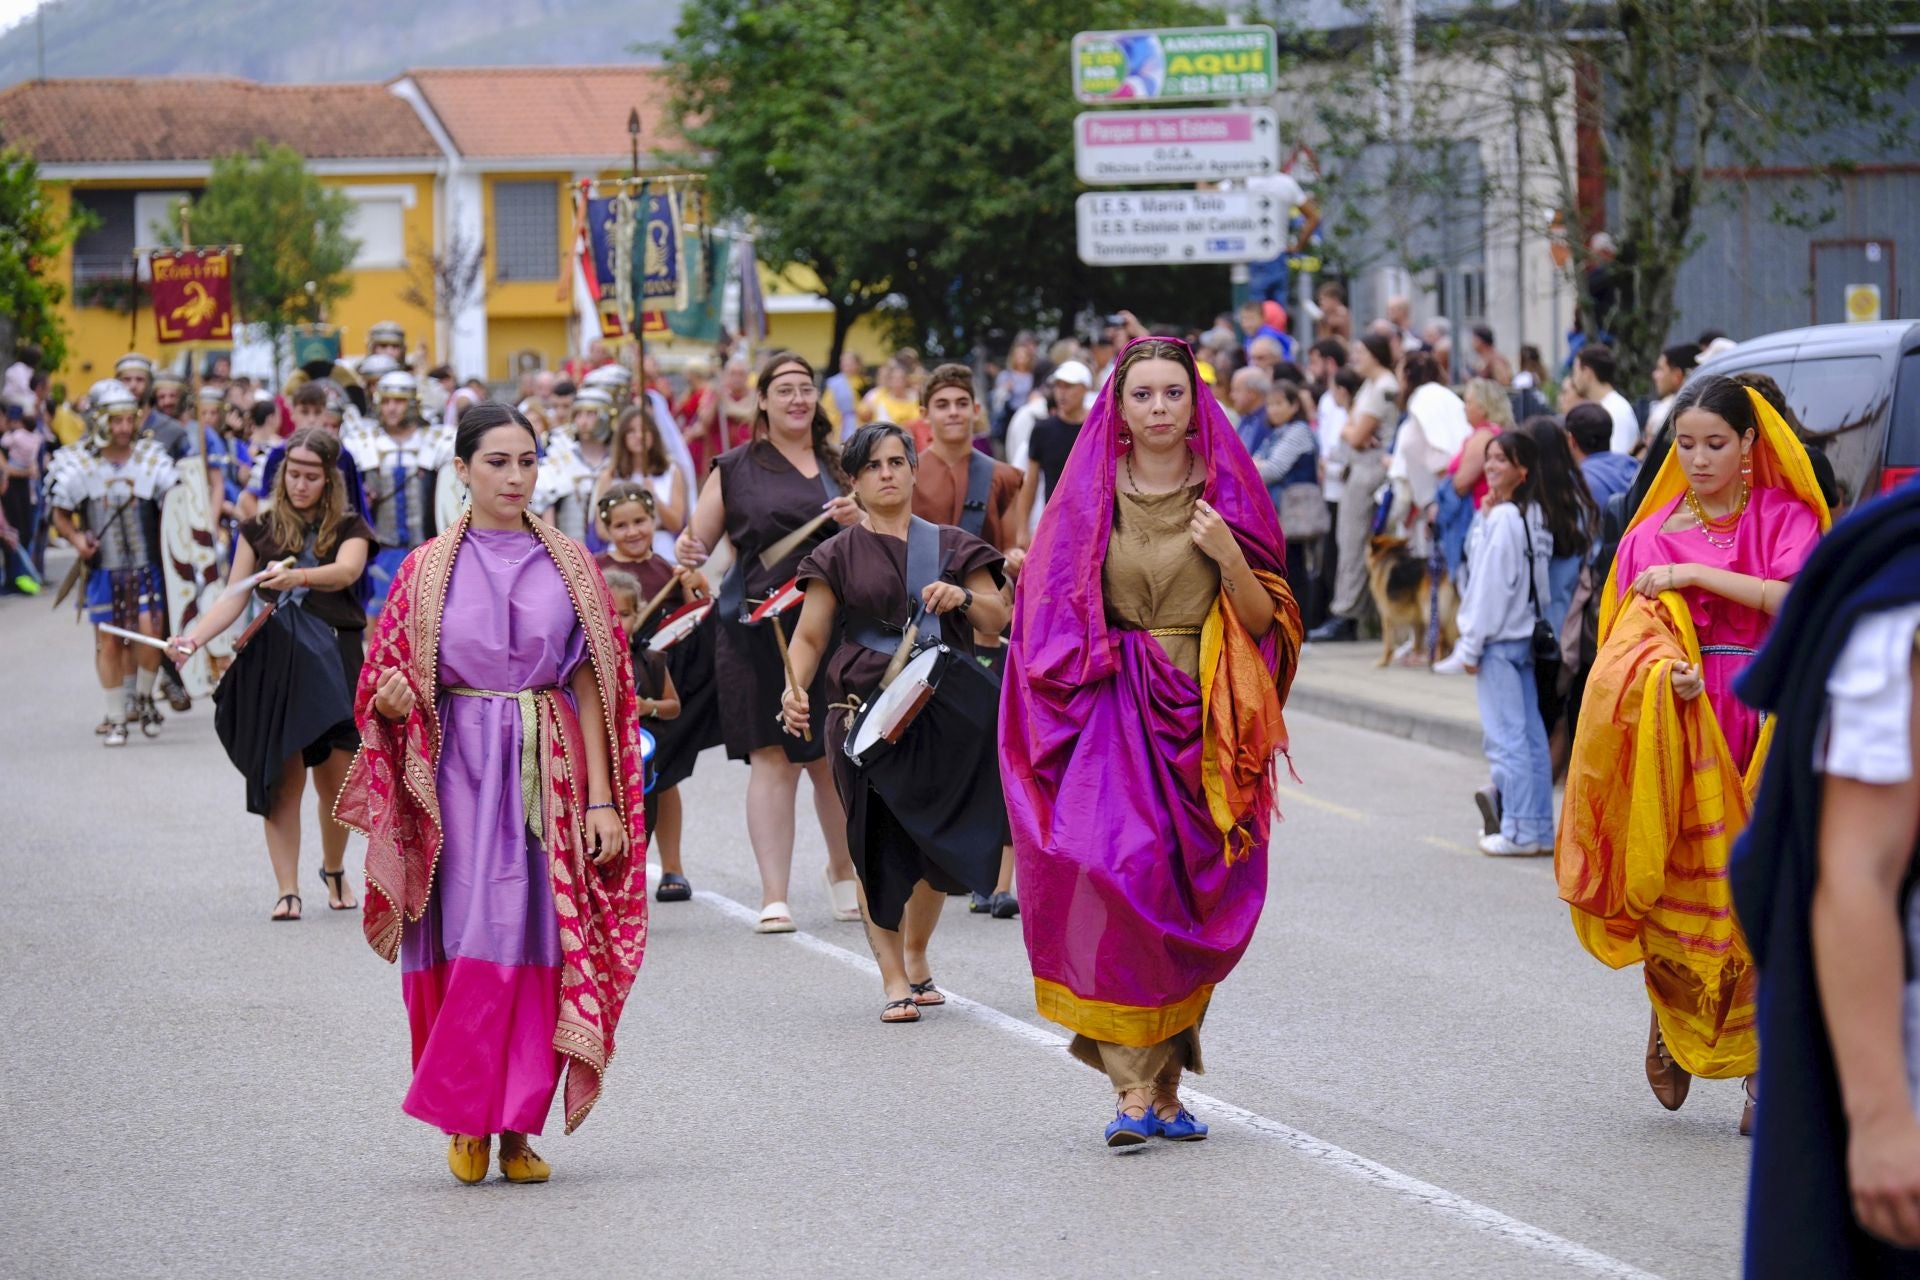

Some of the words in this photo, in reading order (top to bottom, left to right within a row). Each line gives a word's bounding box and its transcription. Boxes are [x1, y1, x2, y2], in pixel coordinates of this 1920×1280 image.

[1168, 48, 1264, 75] AQUÍ
[1090, 122, 1136, 142] Parque
[1139, 121, 1154, 139] de
[1096, 162, 1140, 175] Oficina
[1145, 160, 1203, 173] Comarcal
